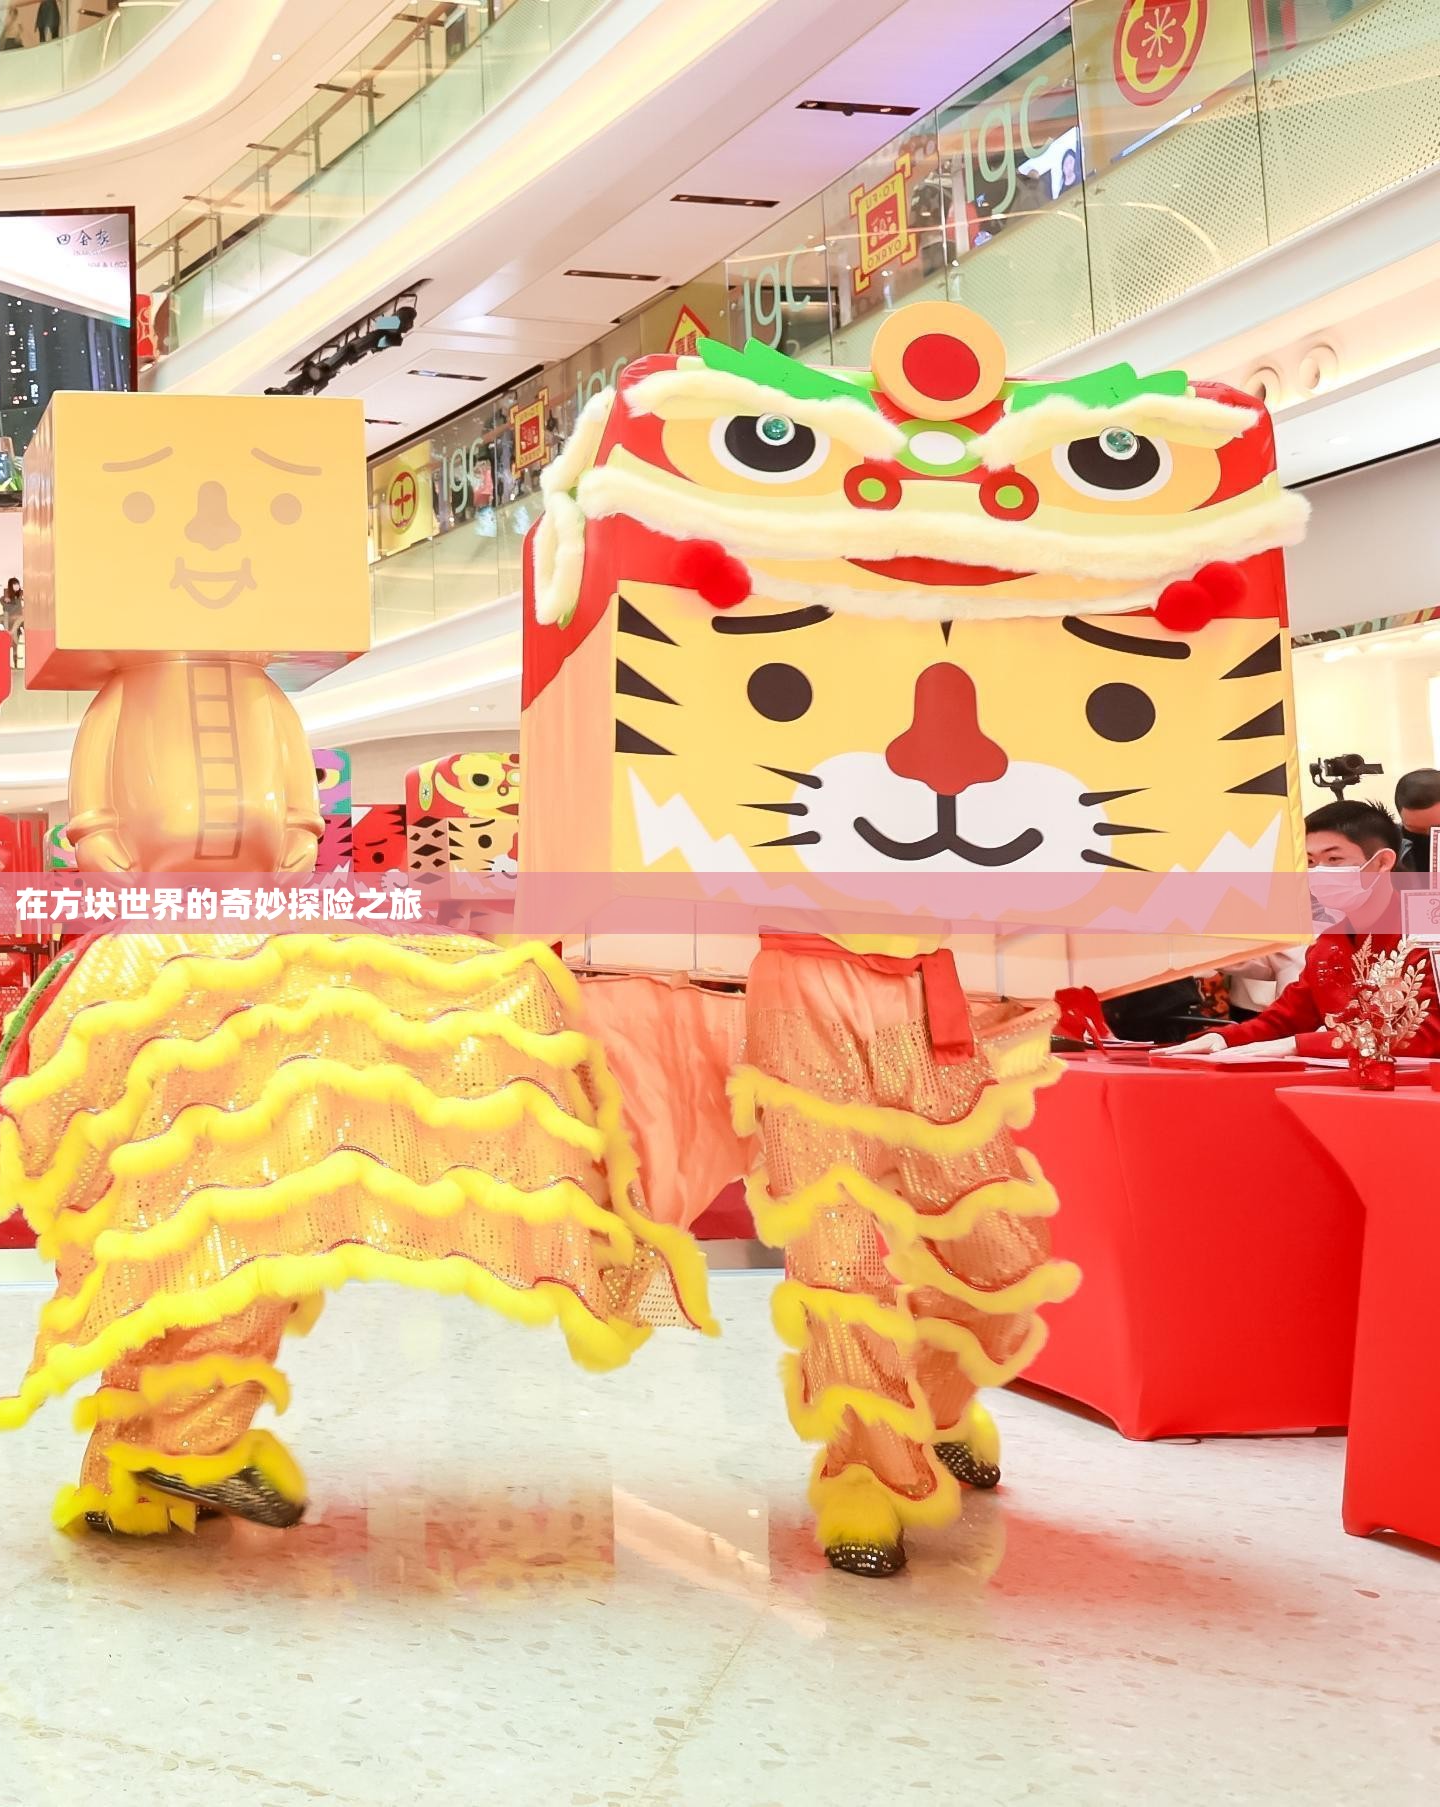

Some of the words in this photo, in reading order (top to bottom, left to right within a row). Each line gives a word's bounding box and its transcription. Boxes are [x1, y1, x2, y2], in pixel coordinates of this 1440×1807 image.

[962, 75, 1049, 214] igc
[742, 244, 811, 350] igc
[440, 436, 484, 514] igc
